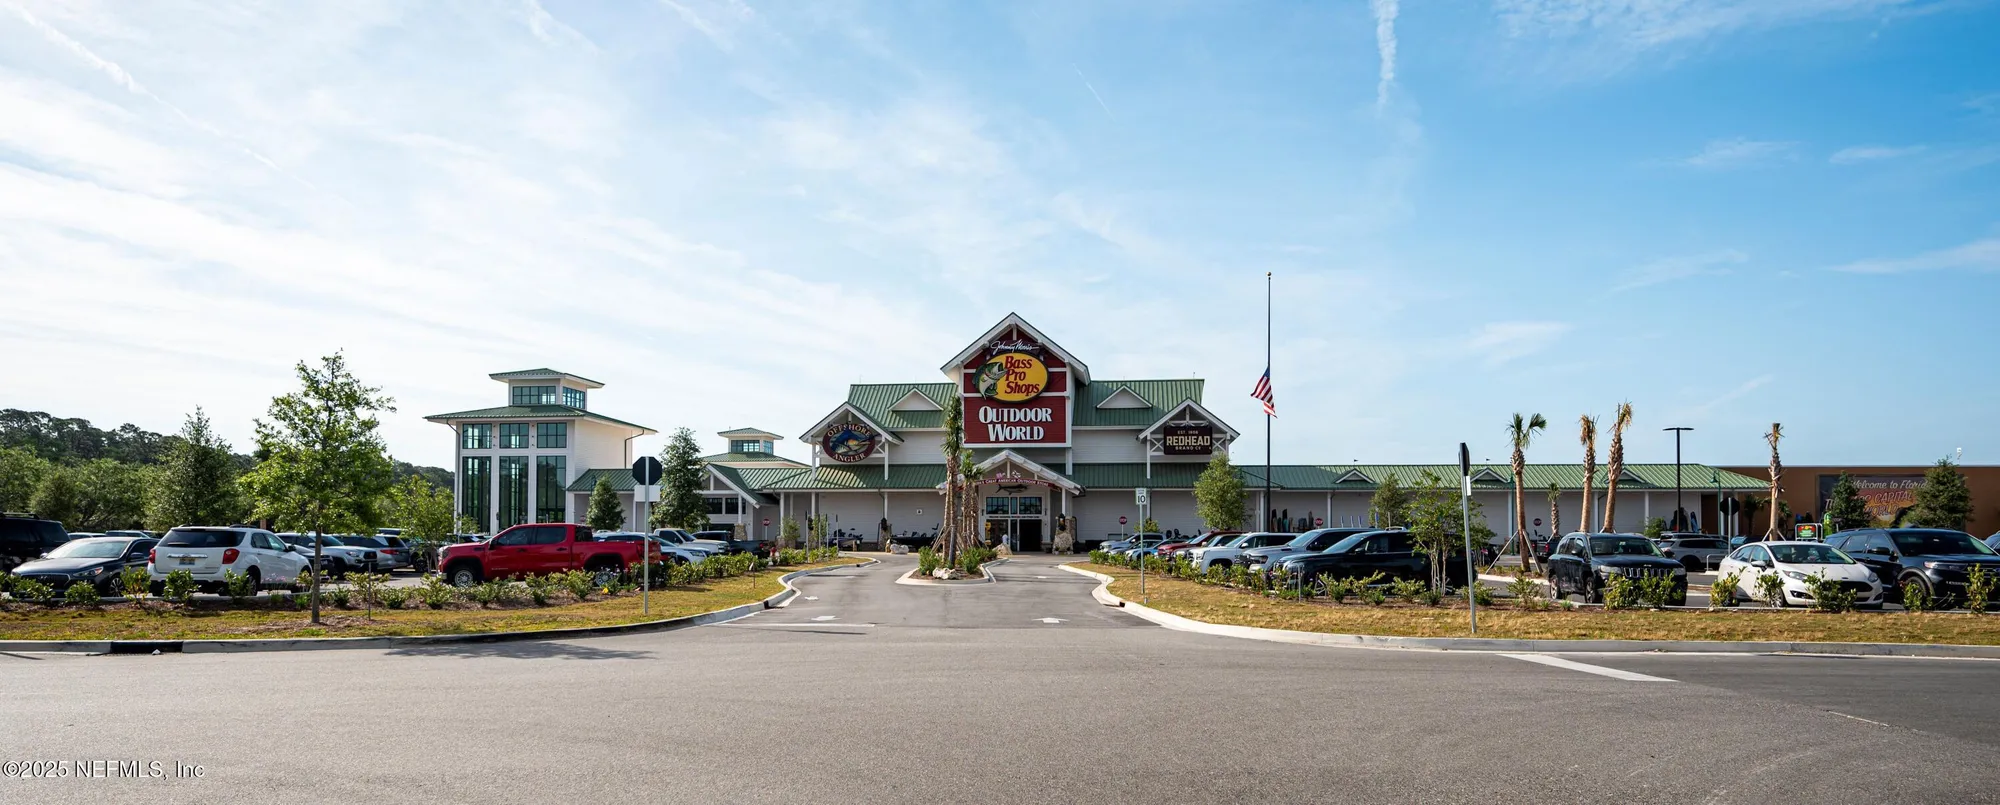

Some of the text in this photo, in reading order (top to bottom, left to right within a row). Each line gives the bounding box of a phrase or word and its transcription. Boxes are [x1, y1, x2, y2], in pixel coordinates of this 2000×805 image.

[1004, 355, 1032, 369] Bass
[1005, 369, 1026, 381] Pro
[1004, 381, 1040, 396] Shops
[979, 406, 1052, 423] OUTDOOR
[827, 424, 872, 437] OFFSHORE
[988, 424, 1044, 442] WORLD
[1166, 436, 1210, 446] REDHEAD
[833, 453, 865, 462] ANGLER
[1852, 480, 1929, 489] Welcome to Florid
[1137, 495, 1146, 503] 10
[1875, 490, 1913, 503] CAPITAL
